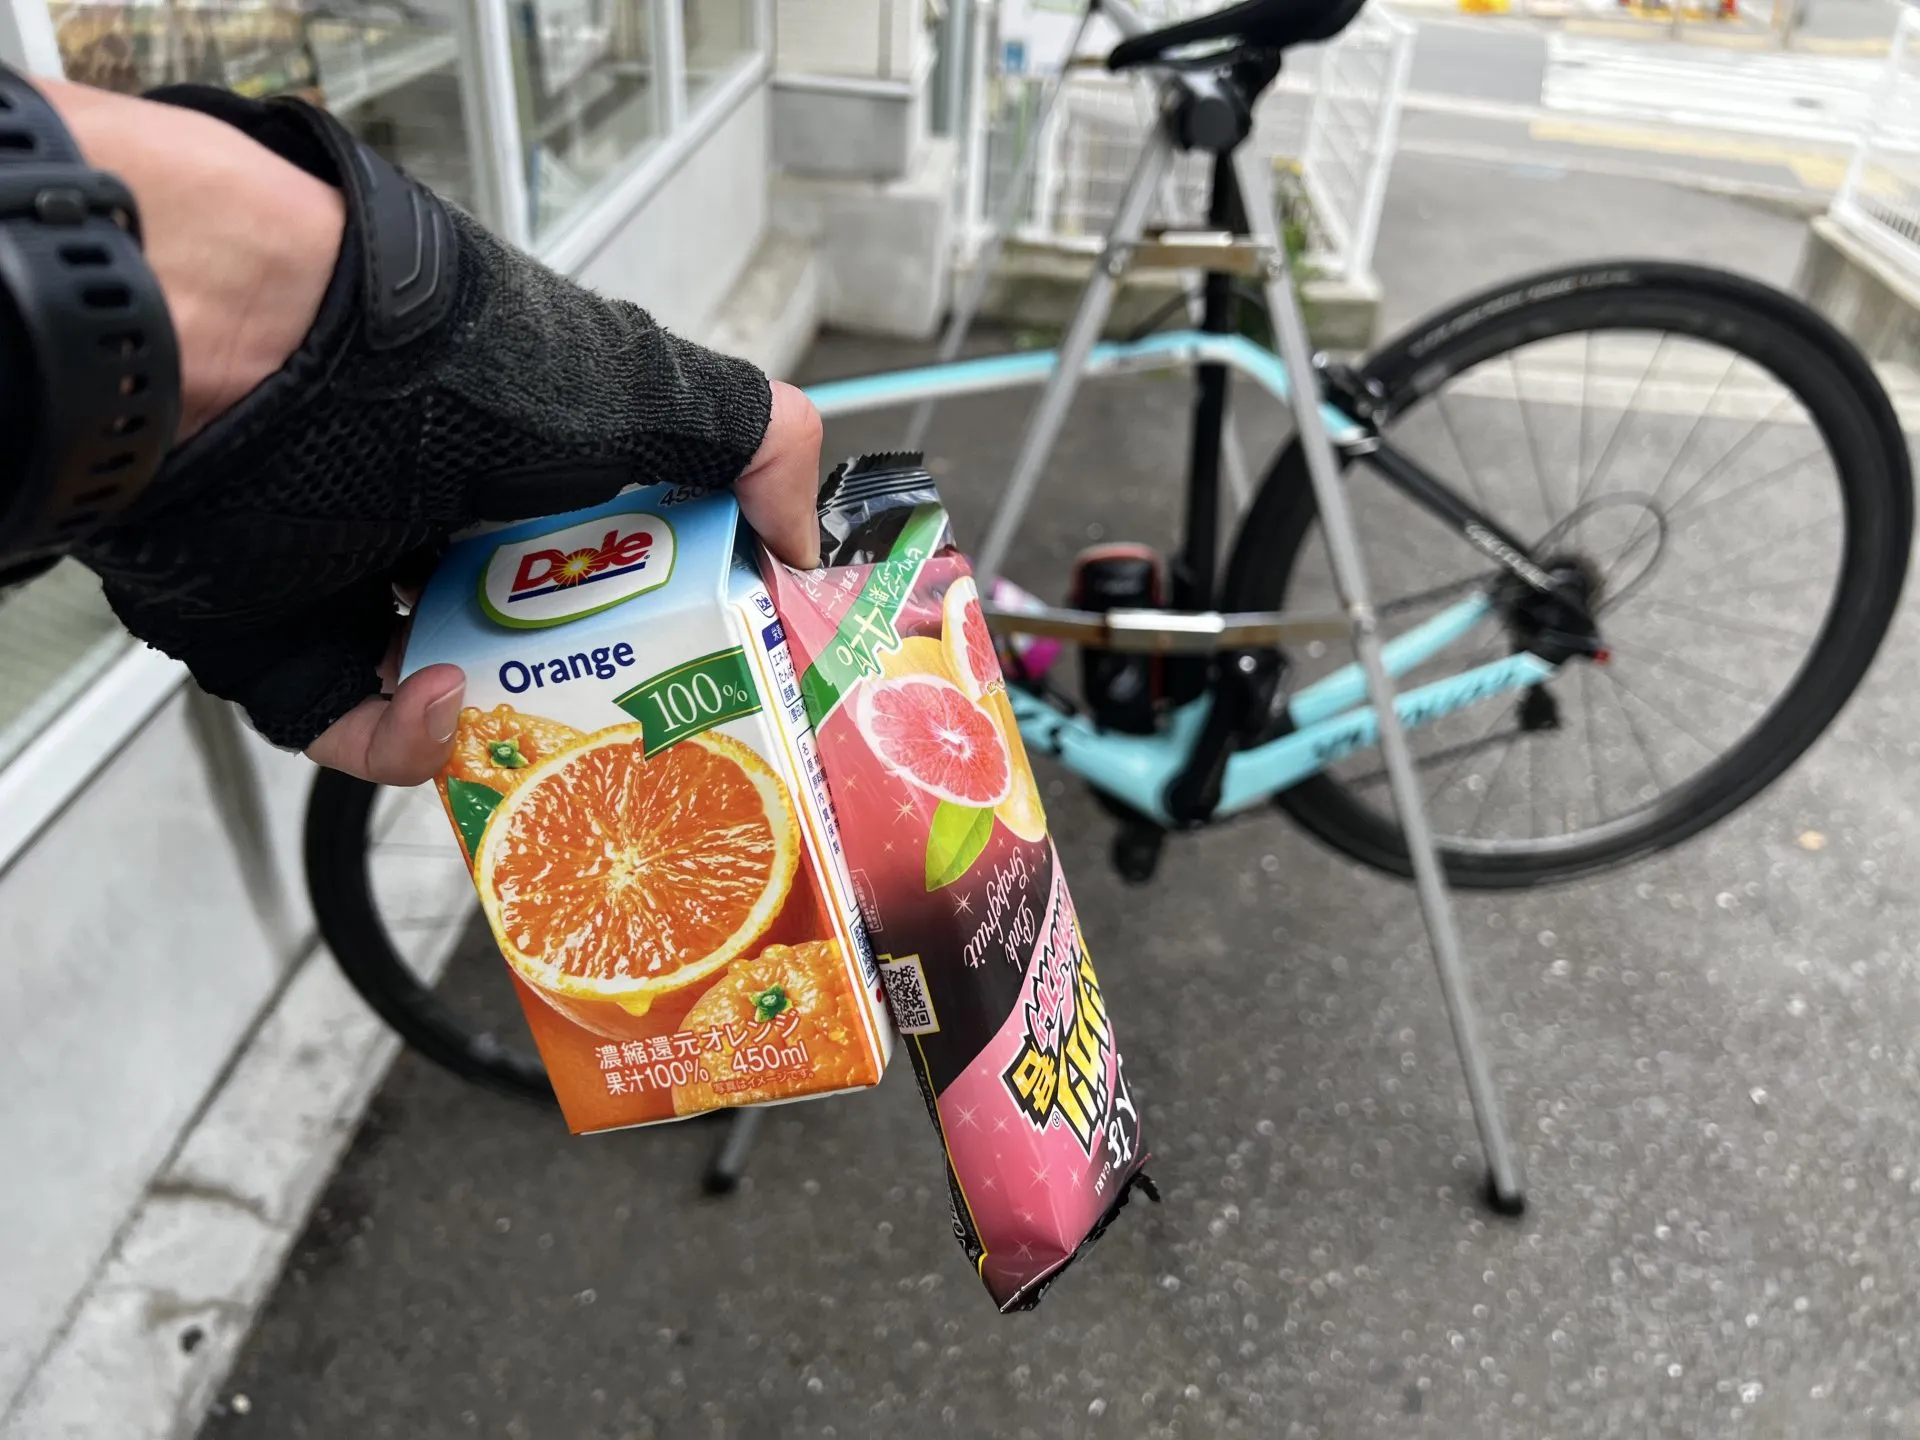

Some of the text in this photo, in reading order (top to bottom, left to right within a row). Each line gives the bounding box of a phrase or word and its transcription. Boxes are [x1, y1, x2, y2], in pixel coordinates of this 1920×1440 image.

[511, 529, 653, 593] Dole
[499, 641, 637, 694] Orange
[648, 672, 748, 733] 100%
[963, 846, 1030, 969] Grapefruit
[1004, 894, 1036, 974] Pink
[604, 1041, 809, 1097] 果汁100% 450ml
